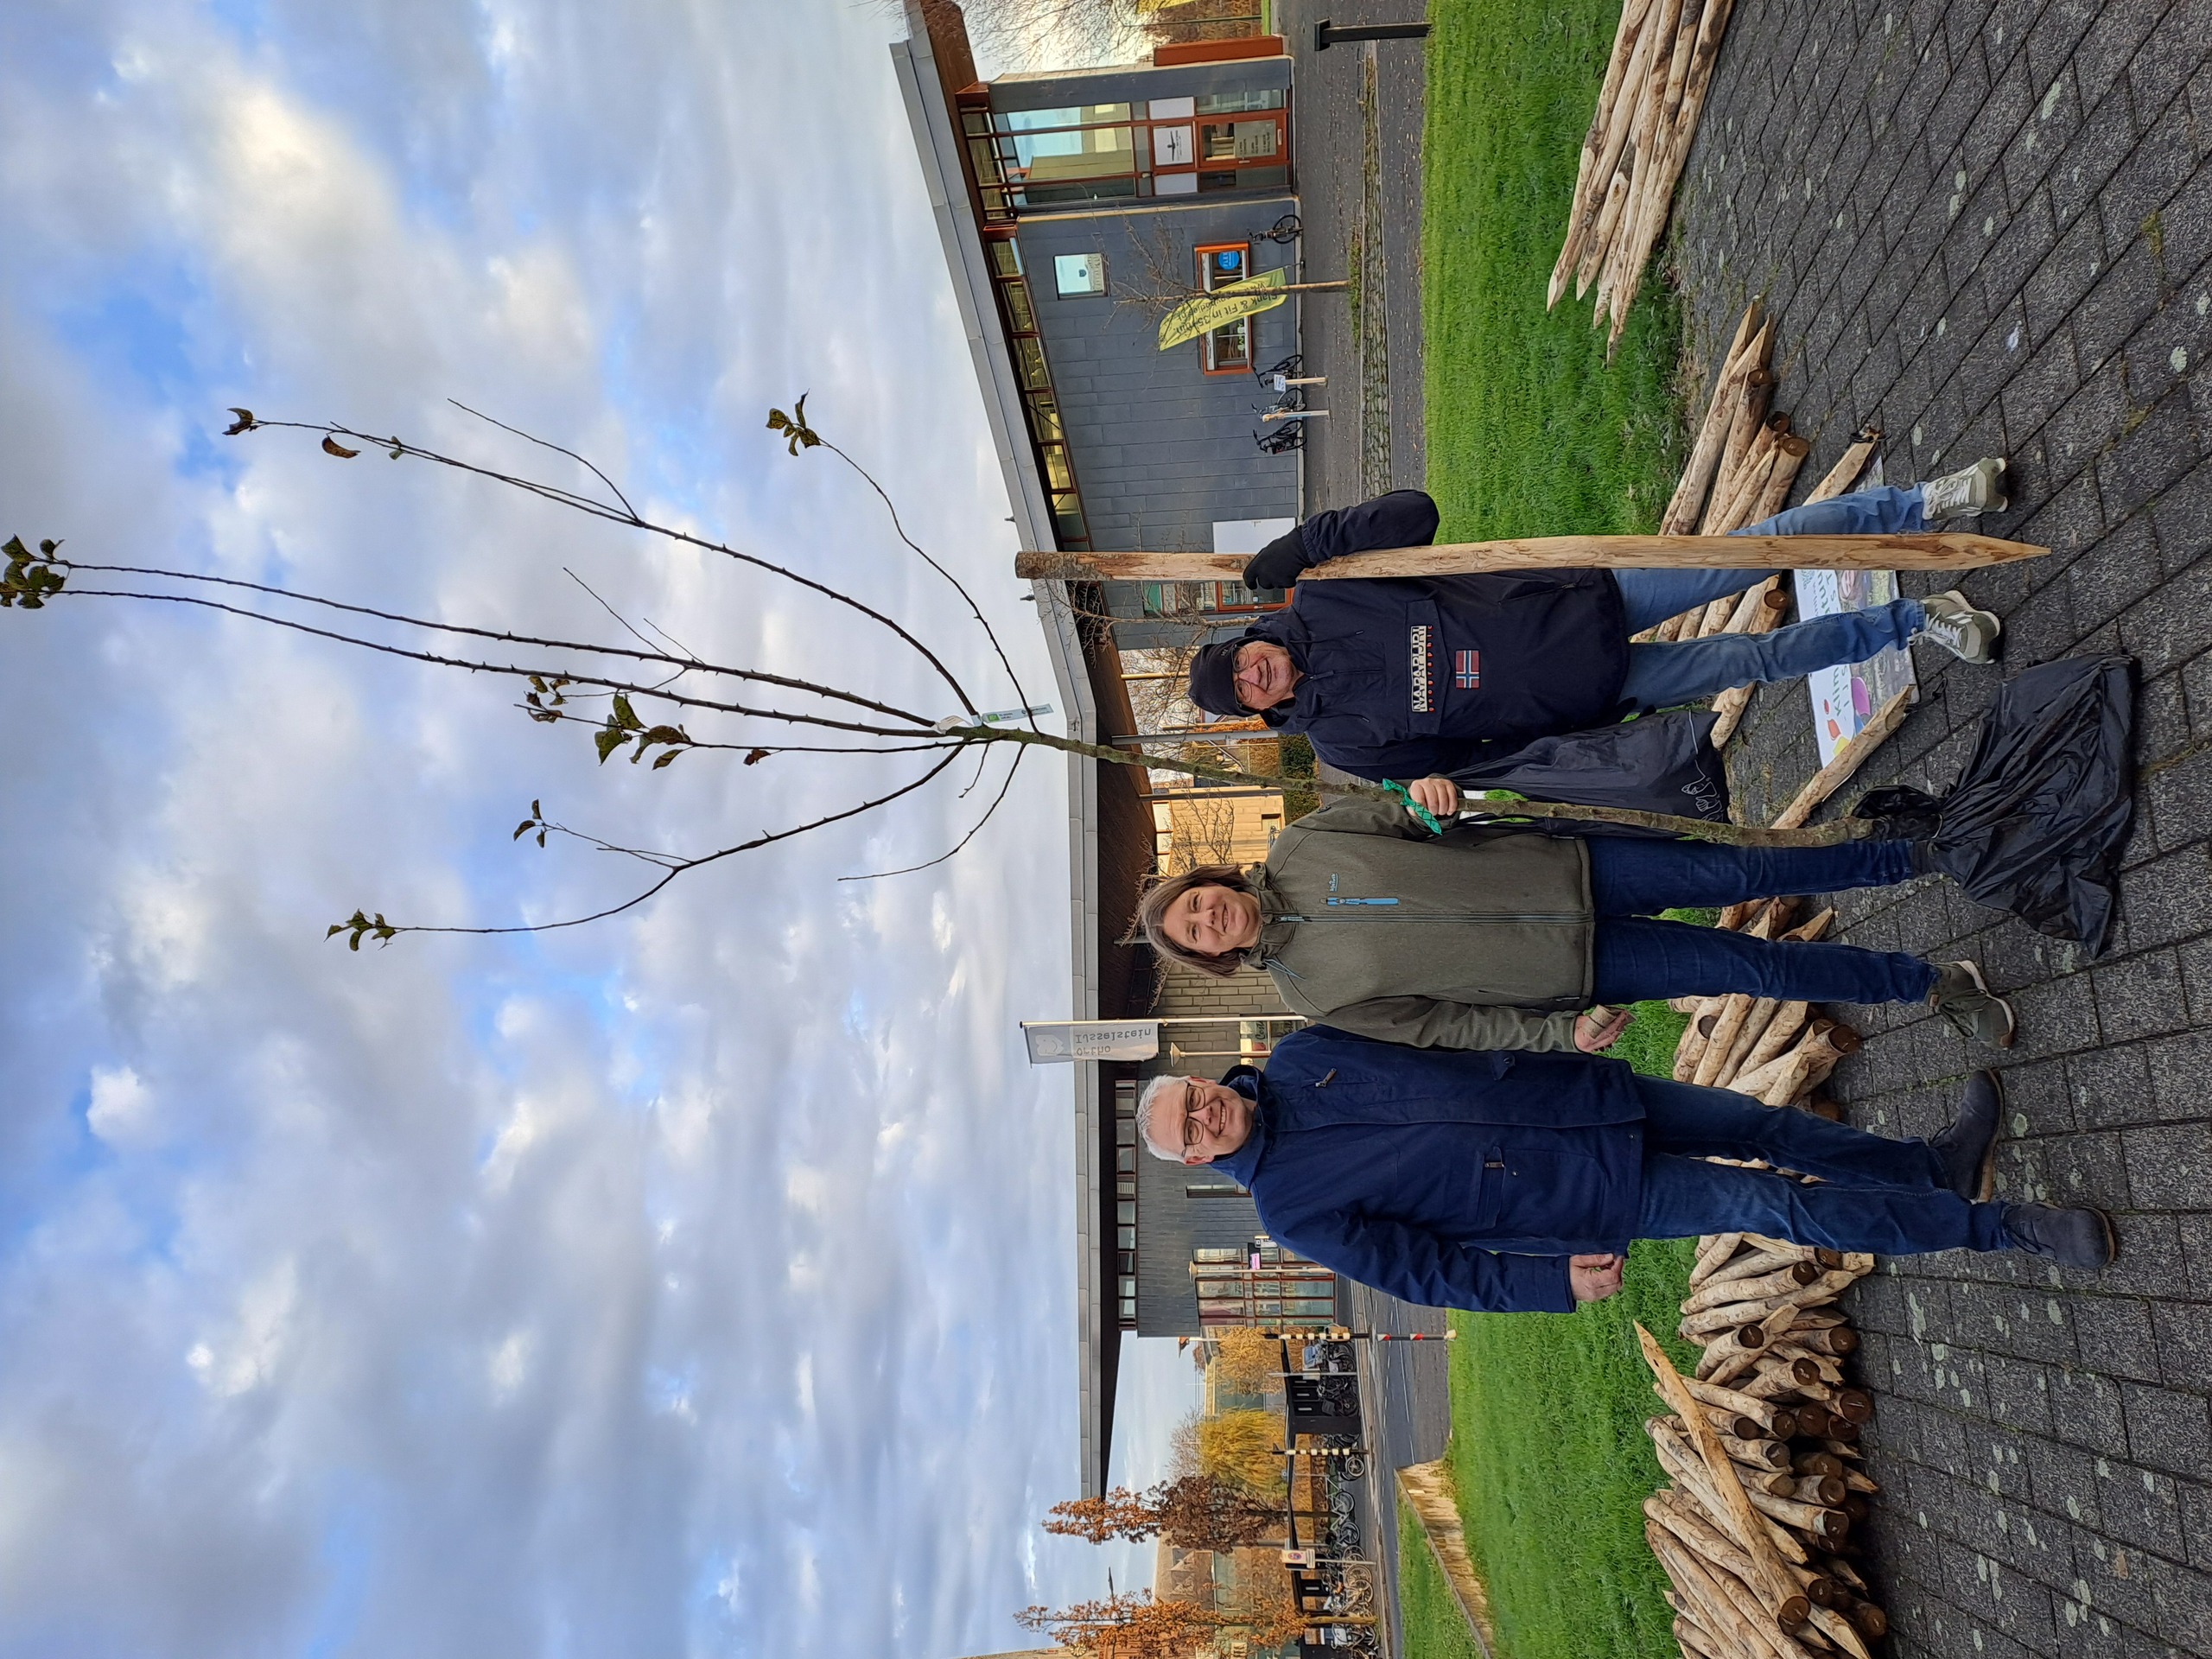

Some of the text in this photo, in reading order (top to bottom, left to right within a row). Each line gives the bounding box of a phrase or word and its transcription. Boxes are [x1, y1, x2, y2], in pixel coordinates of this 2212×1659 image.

[1212, 309, 1223, 318] in
[1224, 303, 1238, 315] Fit
[1197, 311, 1210, 327] 35
[1413, 627, 1426, 710] NAPAPIJRI
